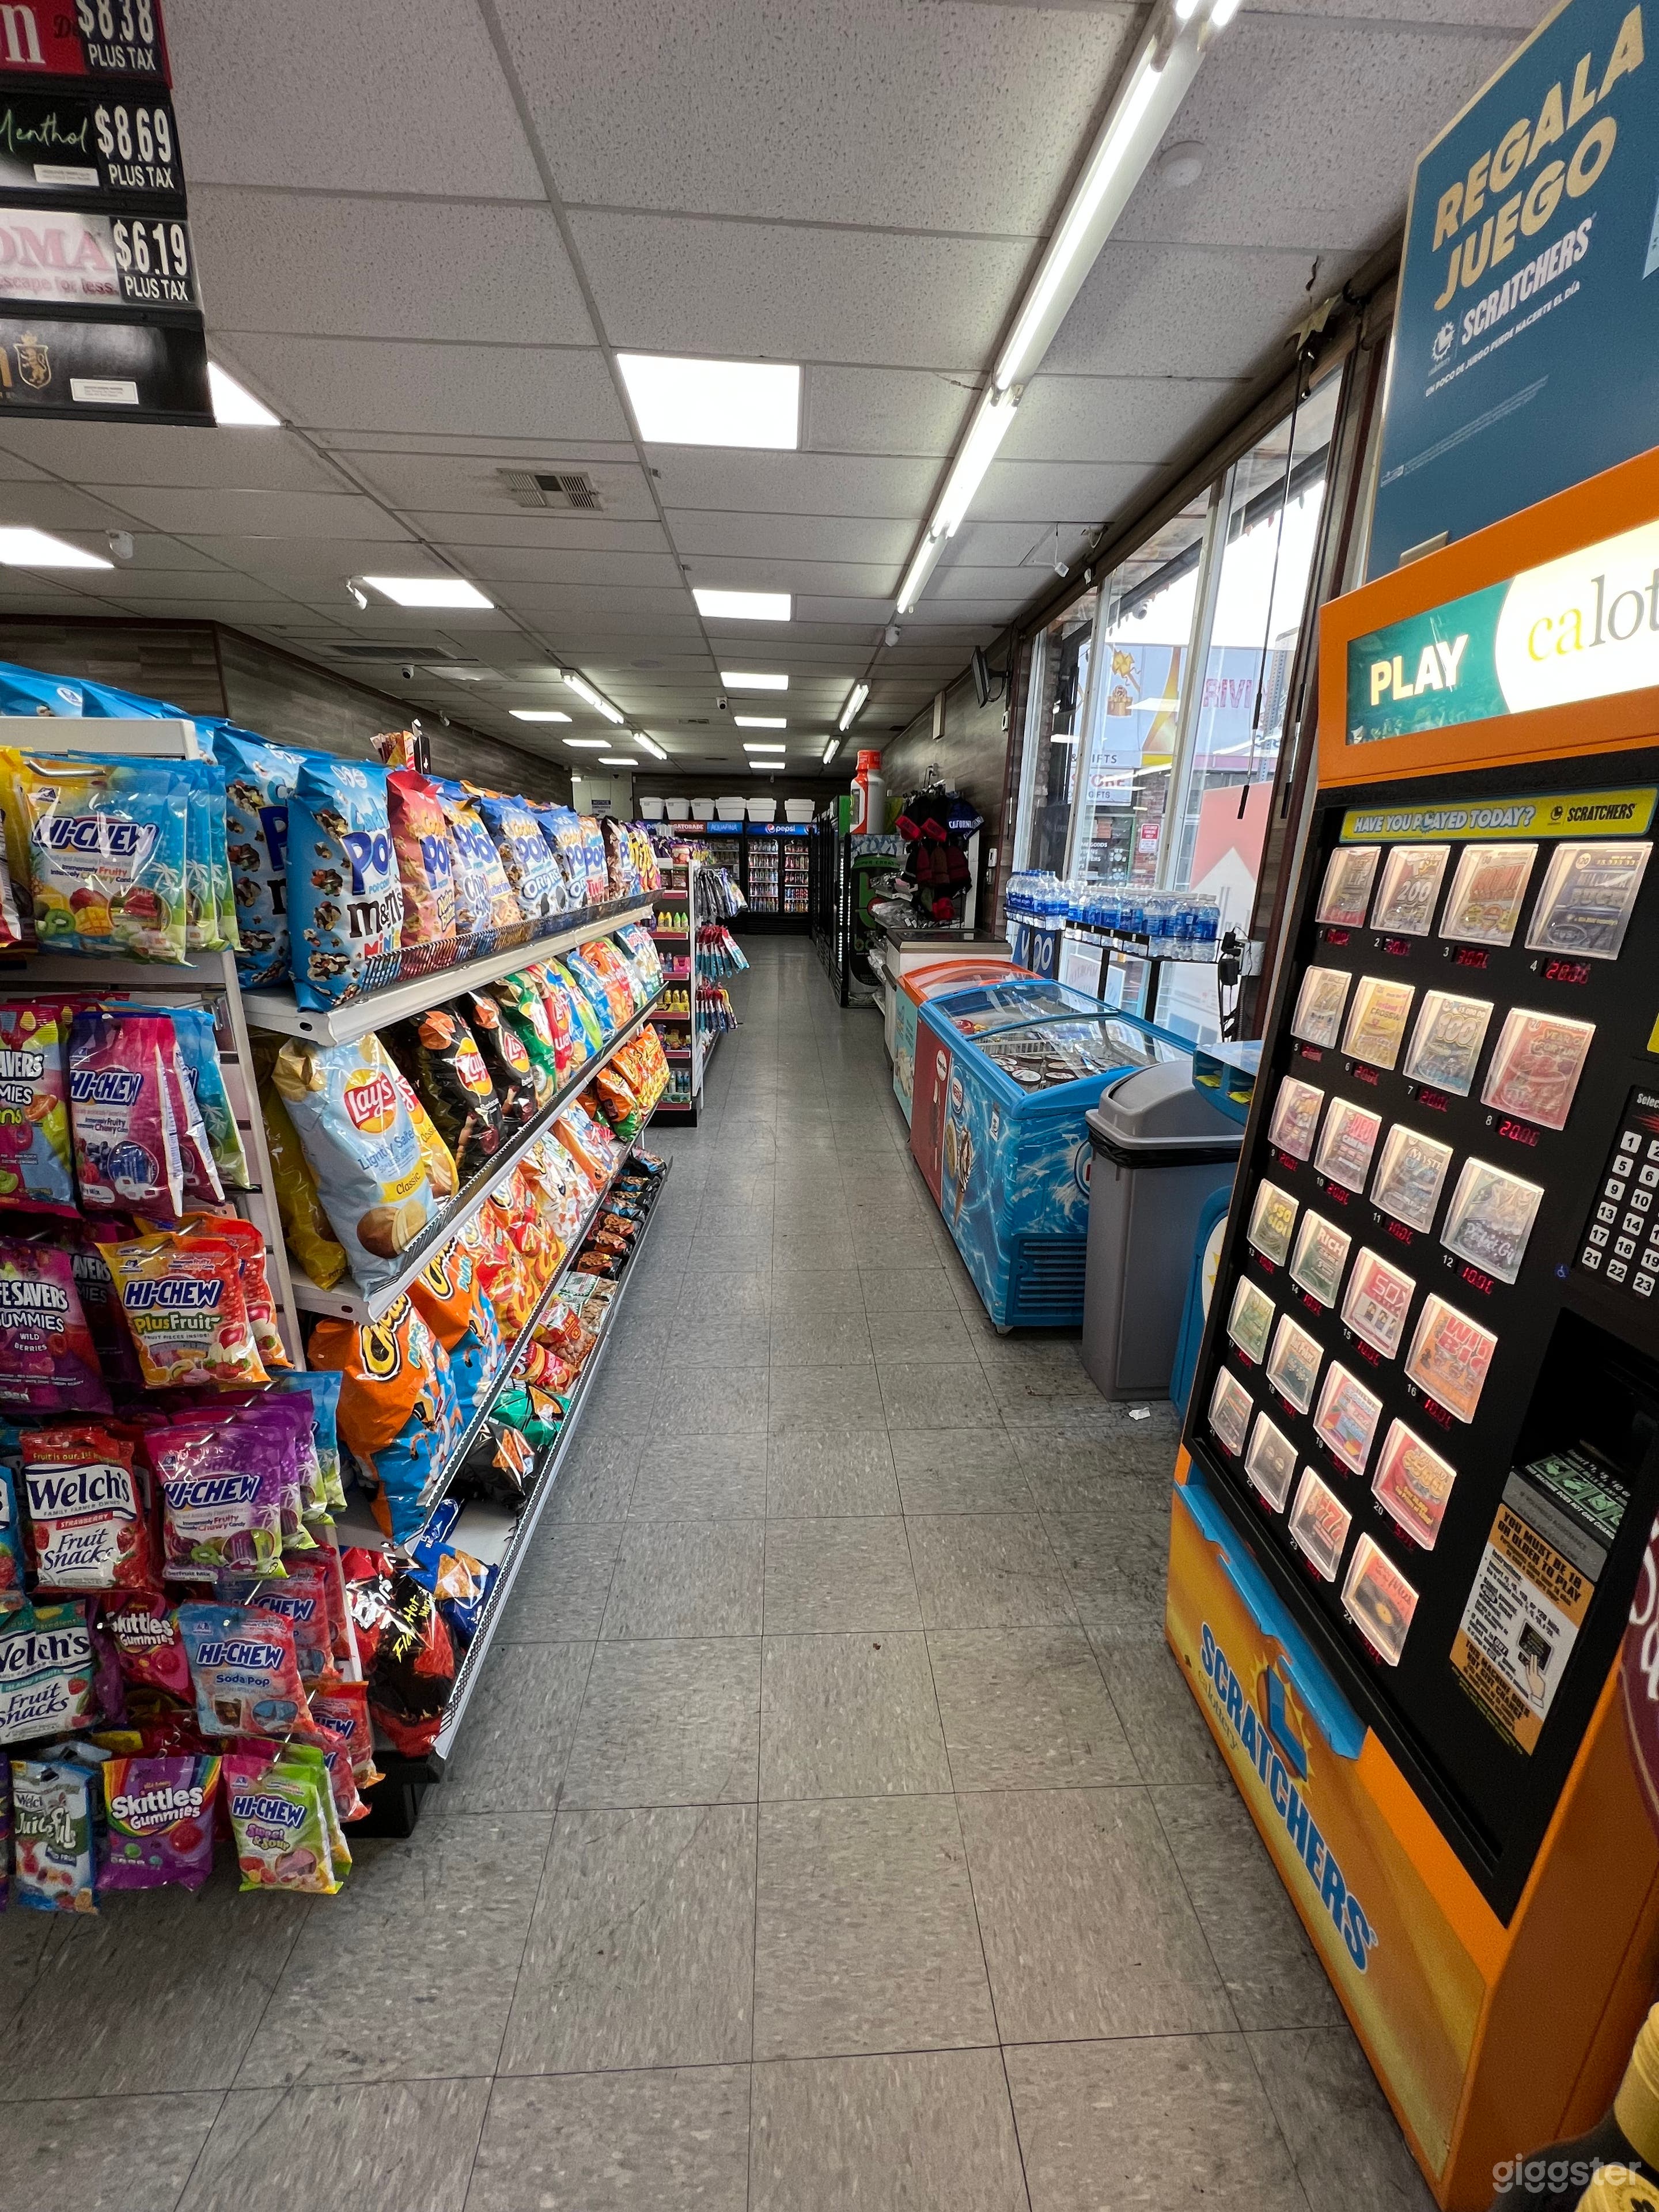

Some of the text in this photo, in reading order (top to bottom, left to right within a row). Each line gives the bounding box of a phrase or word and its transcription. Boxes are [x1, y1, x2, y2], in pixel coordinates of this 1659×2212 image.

[88, 44, 156, 70] PLUS TAX
[94, 104, 172, 162] $8.69
[1432, 5, 1645, 252] REGALA
[108, 164, 145, 187] PLUS
[146, 166, 175, 190] TAX
[1434, 116, 1616, 311] JUEGO
[113, 219, 188, 275] $6.19
[1461, 215, 1593, 345] SCRATCHERS
[124, 276, 189, 301] PLUS TAX
[1370, 634, 1469, 706] PLAY
[1092, 754, 1117, 764] IFTS
[1354, 816, 1382, 833] HAVE
[1385, 812, 1411, 831] YOU
[1470, 806, 1536, 828] TODAY?
[1567, 804, 1635, 822] SCRATCHERS
[710, 823, 738, 832] AQUAFINA
[775, 824, 796, 832] pepsi
[32, 815, 159, 857] HI-CHEW
[98, 866, 128, 877] Fruity
[1396, 880, 1434, 903] 200
[1374, 938, 1380, 947] 2
[1443, 947, 1449, 957] 3
[1529, 960, 1538, 972] 4
[1345, 1062, 1350, 1071] 6
[70, 1069, 143, 1105] HI-CHEW
[1407, 1086, 1414, 1094] 7
[348, 1077, 393, 1123] Lay's
[107, 1118, 126, 1127] Fruity
[1486, 1115, 1493, 1126] 8
[1628, 1137, 1634, 1148] 1
[358, 1142, 393, 1171] Lightly
[1618, 1161, 1626, 1172] 5
[1316, 1176, 1324, 1187] 10
[1646, 1171, 1653, 1182] 6
[396, 1172, 421, 1196] Classic
[1611, 1184, 1619, 1195] 9
[1634, 1194, 1649, 1206] 10
[1373, 1213, 1381, 1223] 11
[1599, 1206, 1613, 1219] 13
[1626, 1217, 1641, 1232] 14
[1318, 1228, 1345, 1256] RICH
[1593, 1229, 1607, 1243] 17
[1618, 1241, 1633, 1255] 18
[1443, 1255, 1453, 1267] 12
[1584, 1252, 1599, 1266] 21
[1645, 1253, 1659, 1267] 19
[1609, 1264, 1625, 1279] 22
[1291, 1284, 1298, 1294] 14
[1635, 1277, 1652, 1293] 23
[124, 1279, 225, 1309] HI-CHEW
[0, 1309, 65, 1332] UMMIES
[20, 1332, 40, 1341] WILD
[1343, 1328, 1351, 1340] 15
[14, 1343, 47, 1353] BERRIES
[1407, 1384, 1416, 1397] 16
[33, 1453, 52, 1463] Fruit
[62, 1453, 77, 1461] our
[28, 1469, 129, 1511] Welch's
[163, 1475, 262, 1510] HI-CHEW
[44, 1509, 70, 1517] FAMILY
[71, 1504, 98, 1514] FARMER
[1373, 1502, 1383, 1516] 20
[1570, 1502, 1584, 1513] NOT
[60, 1513, 111, 1529] STRAWBERRY
[213, 1514, 240, 1525] Fruity
[198, 1522, 229, 1533] Chewy
[58, 1529, 109, 1554] Fruit
[1504, 1512, 1582, 1590] YOU MUST BE 18
[43, 1547, 114, 1572] Snacks
[1498, 1520, 1581, 1603] OR OLDER TO PLAY
[120, 1633, 175, 1646] Gummies
[196, 1642, 285, 1669] HI-CHEW
[217, 1673, 271, 1687] Soda Pop
[9, 1683, 61, 1711] Fruit
[112, 1786, 203, 1820] Skittles
[1200, 1620, 1372, 1975] SCRATCHERS
[130, 1805, 200, 1830] Gummies
[232, 1794, 308, 1830] HI-CHEW
[246, 1823, 285, 1842] Sweet
